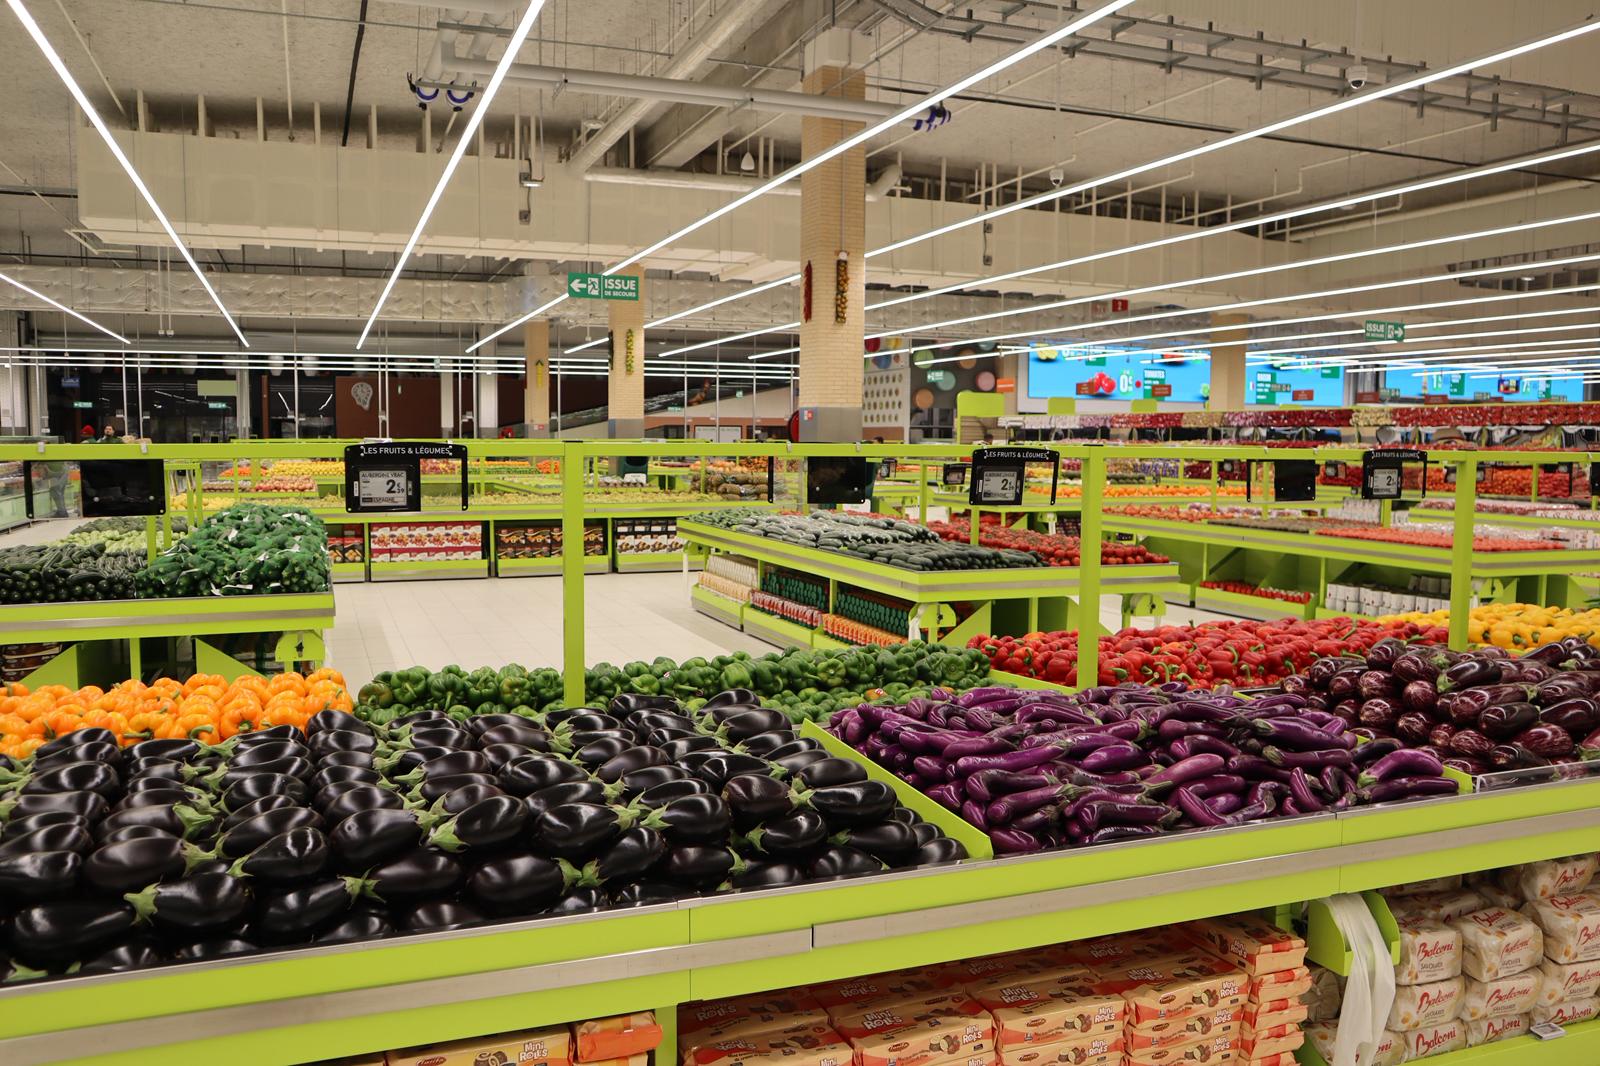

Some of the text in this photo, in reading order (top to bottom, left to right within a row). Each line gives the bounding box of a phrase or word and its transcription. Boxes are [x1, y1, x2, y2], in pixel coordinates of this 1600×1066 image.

[604, 278, 636, 290] ISSUE
[363, 447, 378, 455] LES
[379, 447, 406, 455] FRUITS
[415, 445, 450, 455] LÉGUMES
[1022, 450, 1048, 459] LÉGUMES
[386, 479, 396, 494] 2
[1001, 478, 1009, 491] 2
[1416, 940, 1455, 962] Balconi
[1416, 989, 1456, 1014] Balconi
[1485, 987, 1531, 1008] Balconi
[863, 1015, 903, 1030] ROLLS
[864, 1009, 893, 1022] Mini
[1543, 1005, 1592, 1025] Balconi
[1484, 1018, 1521, 1041] Balconi
[962, 1030, 983, 1045] ROLLS
[1415, 1027, 1456, 1056] Balconi
[525, 1040, 545, 1053] Mini
[519, 1048, 549, 1063] ROLLS
